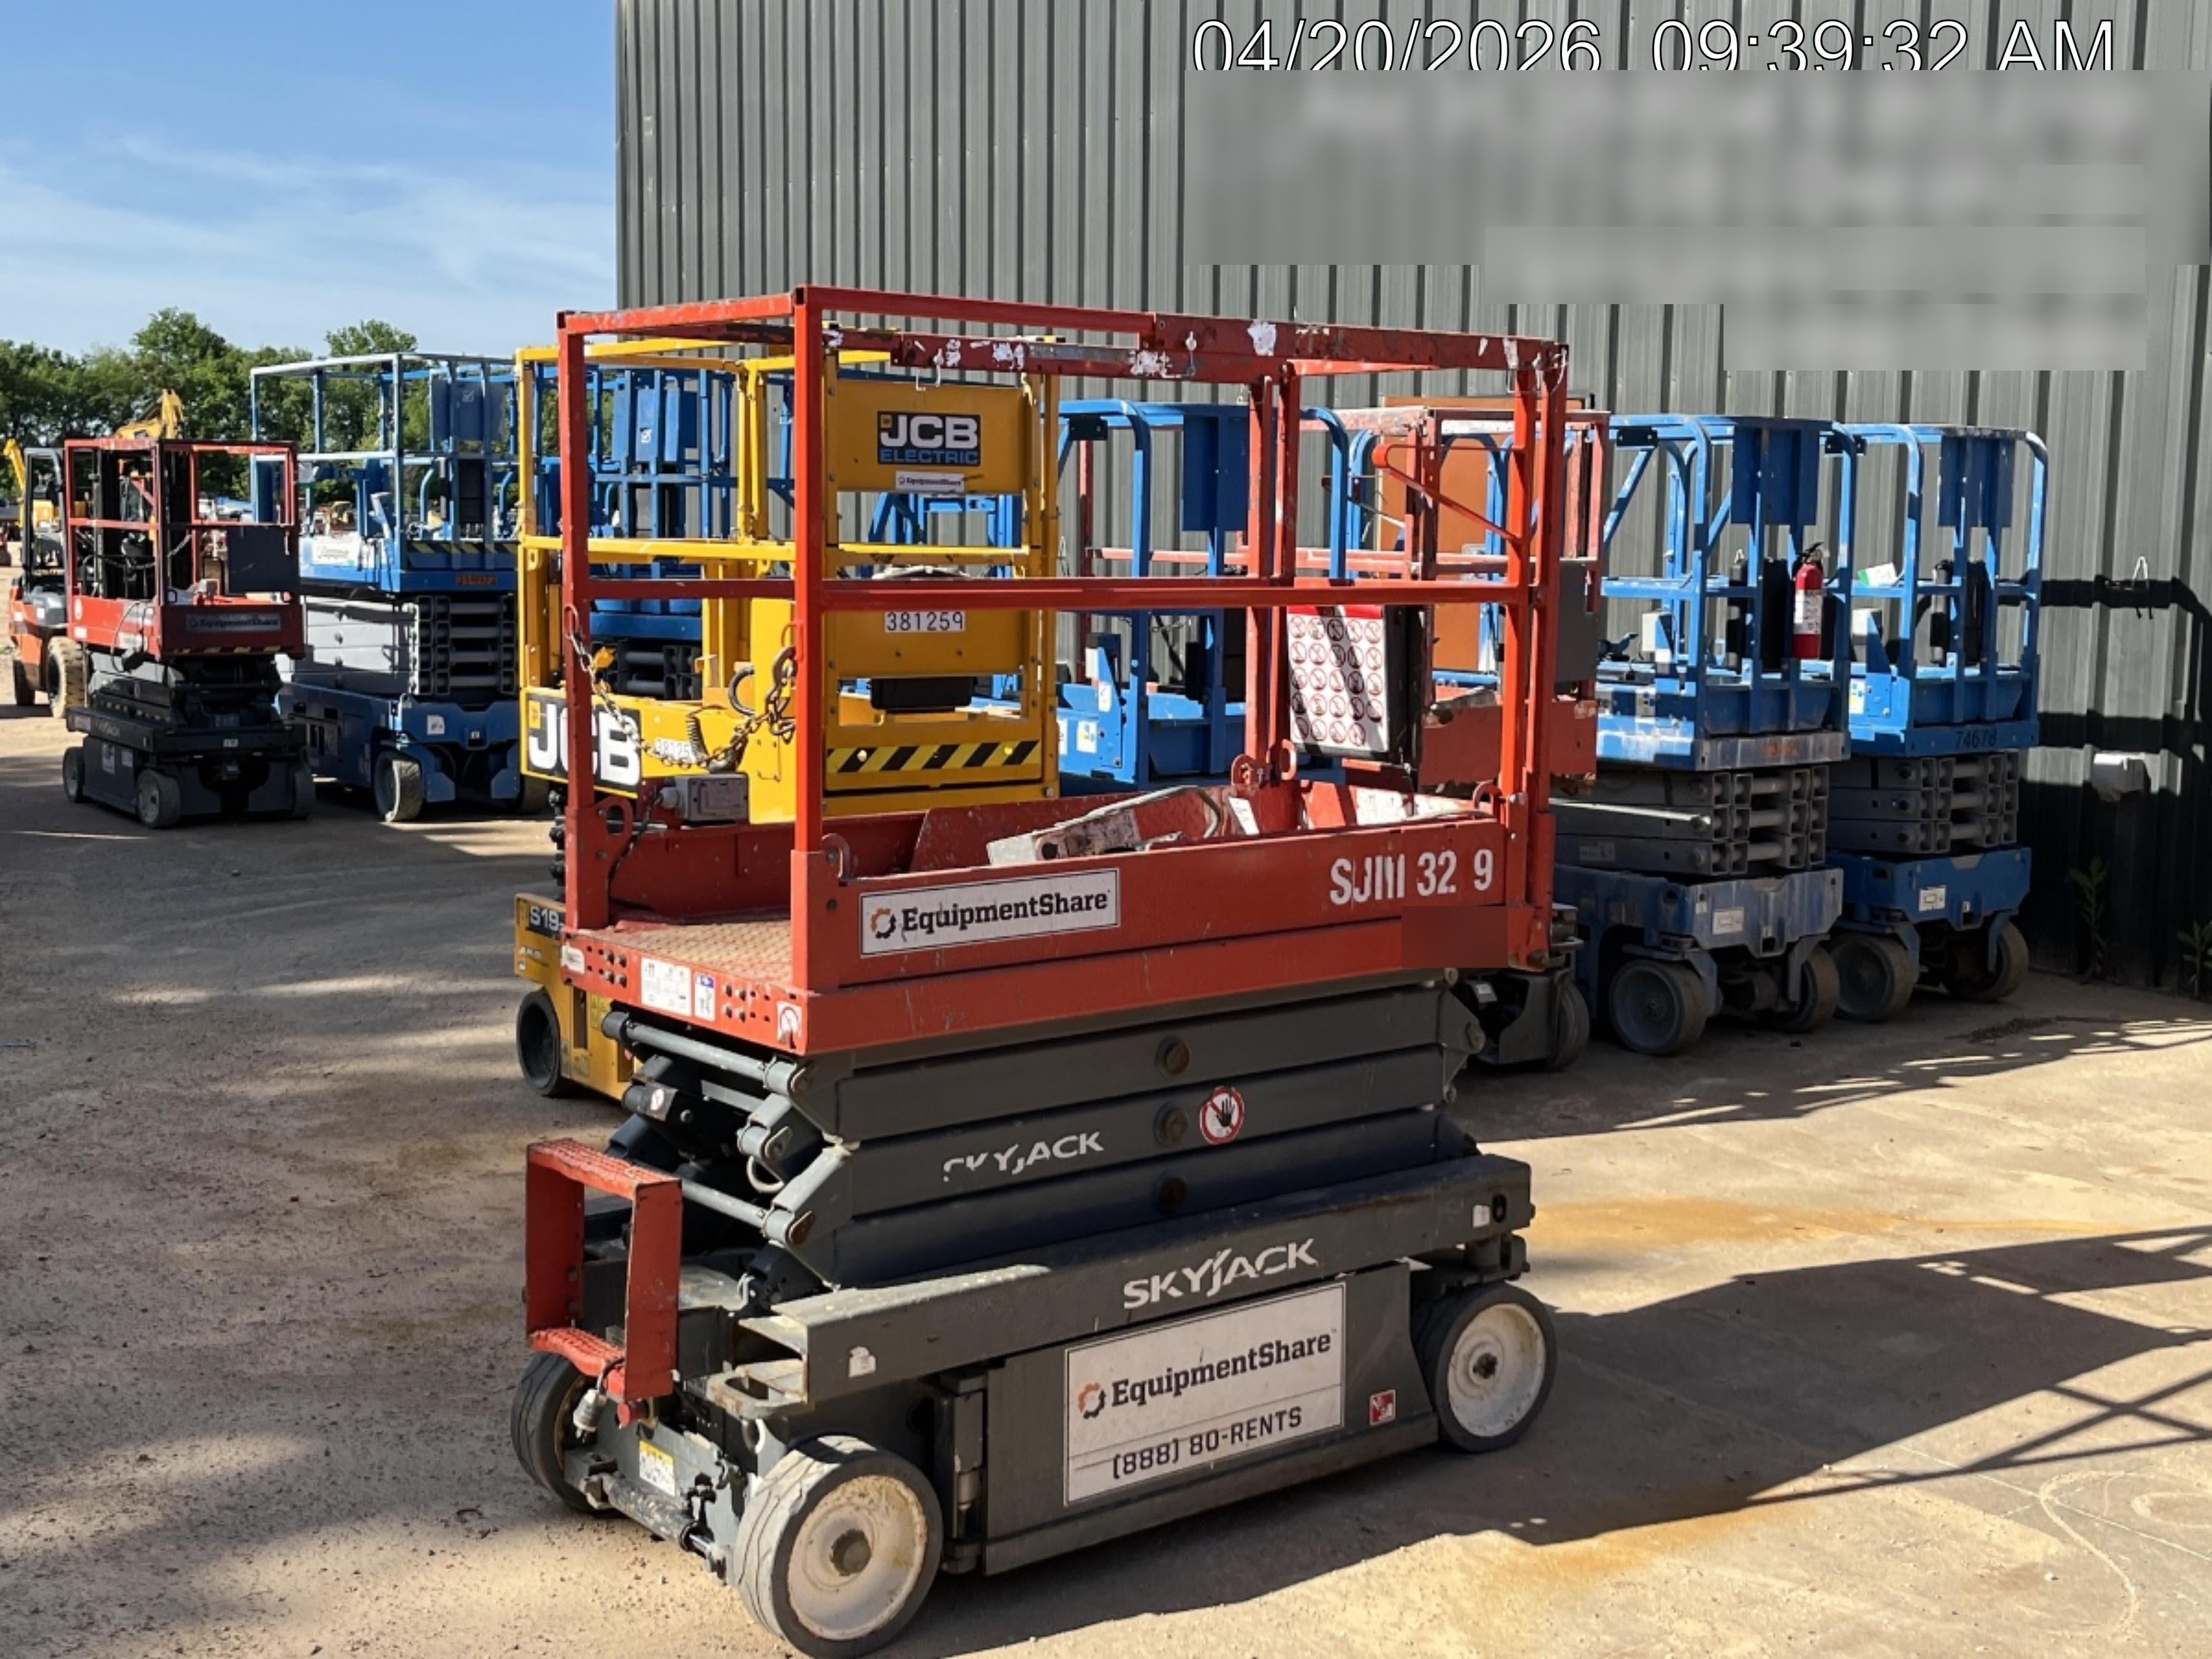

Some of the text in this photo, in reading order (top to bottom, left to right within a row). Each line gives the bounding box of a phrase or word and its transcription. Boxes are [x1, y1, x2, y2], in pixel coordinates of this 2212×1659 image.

[880, 415, 978, 449] JCB
[880, 449, 978, 465] ELECTRIC
[887, 611, 963, 631] 381259
[901, 892, 1107, 935] EquipmentShare
[1123, 1238, 1319, 1309] SKYJACK
[1111, 1333, 1332, 1407] EquipmentShare
[1190, 1406, 1302, 1456] 80-RENTS
